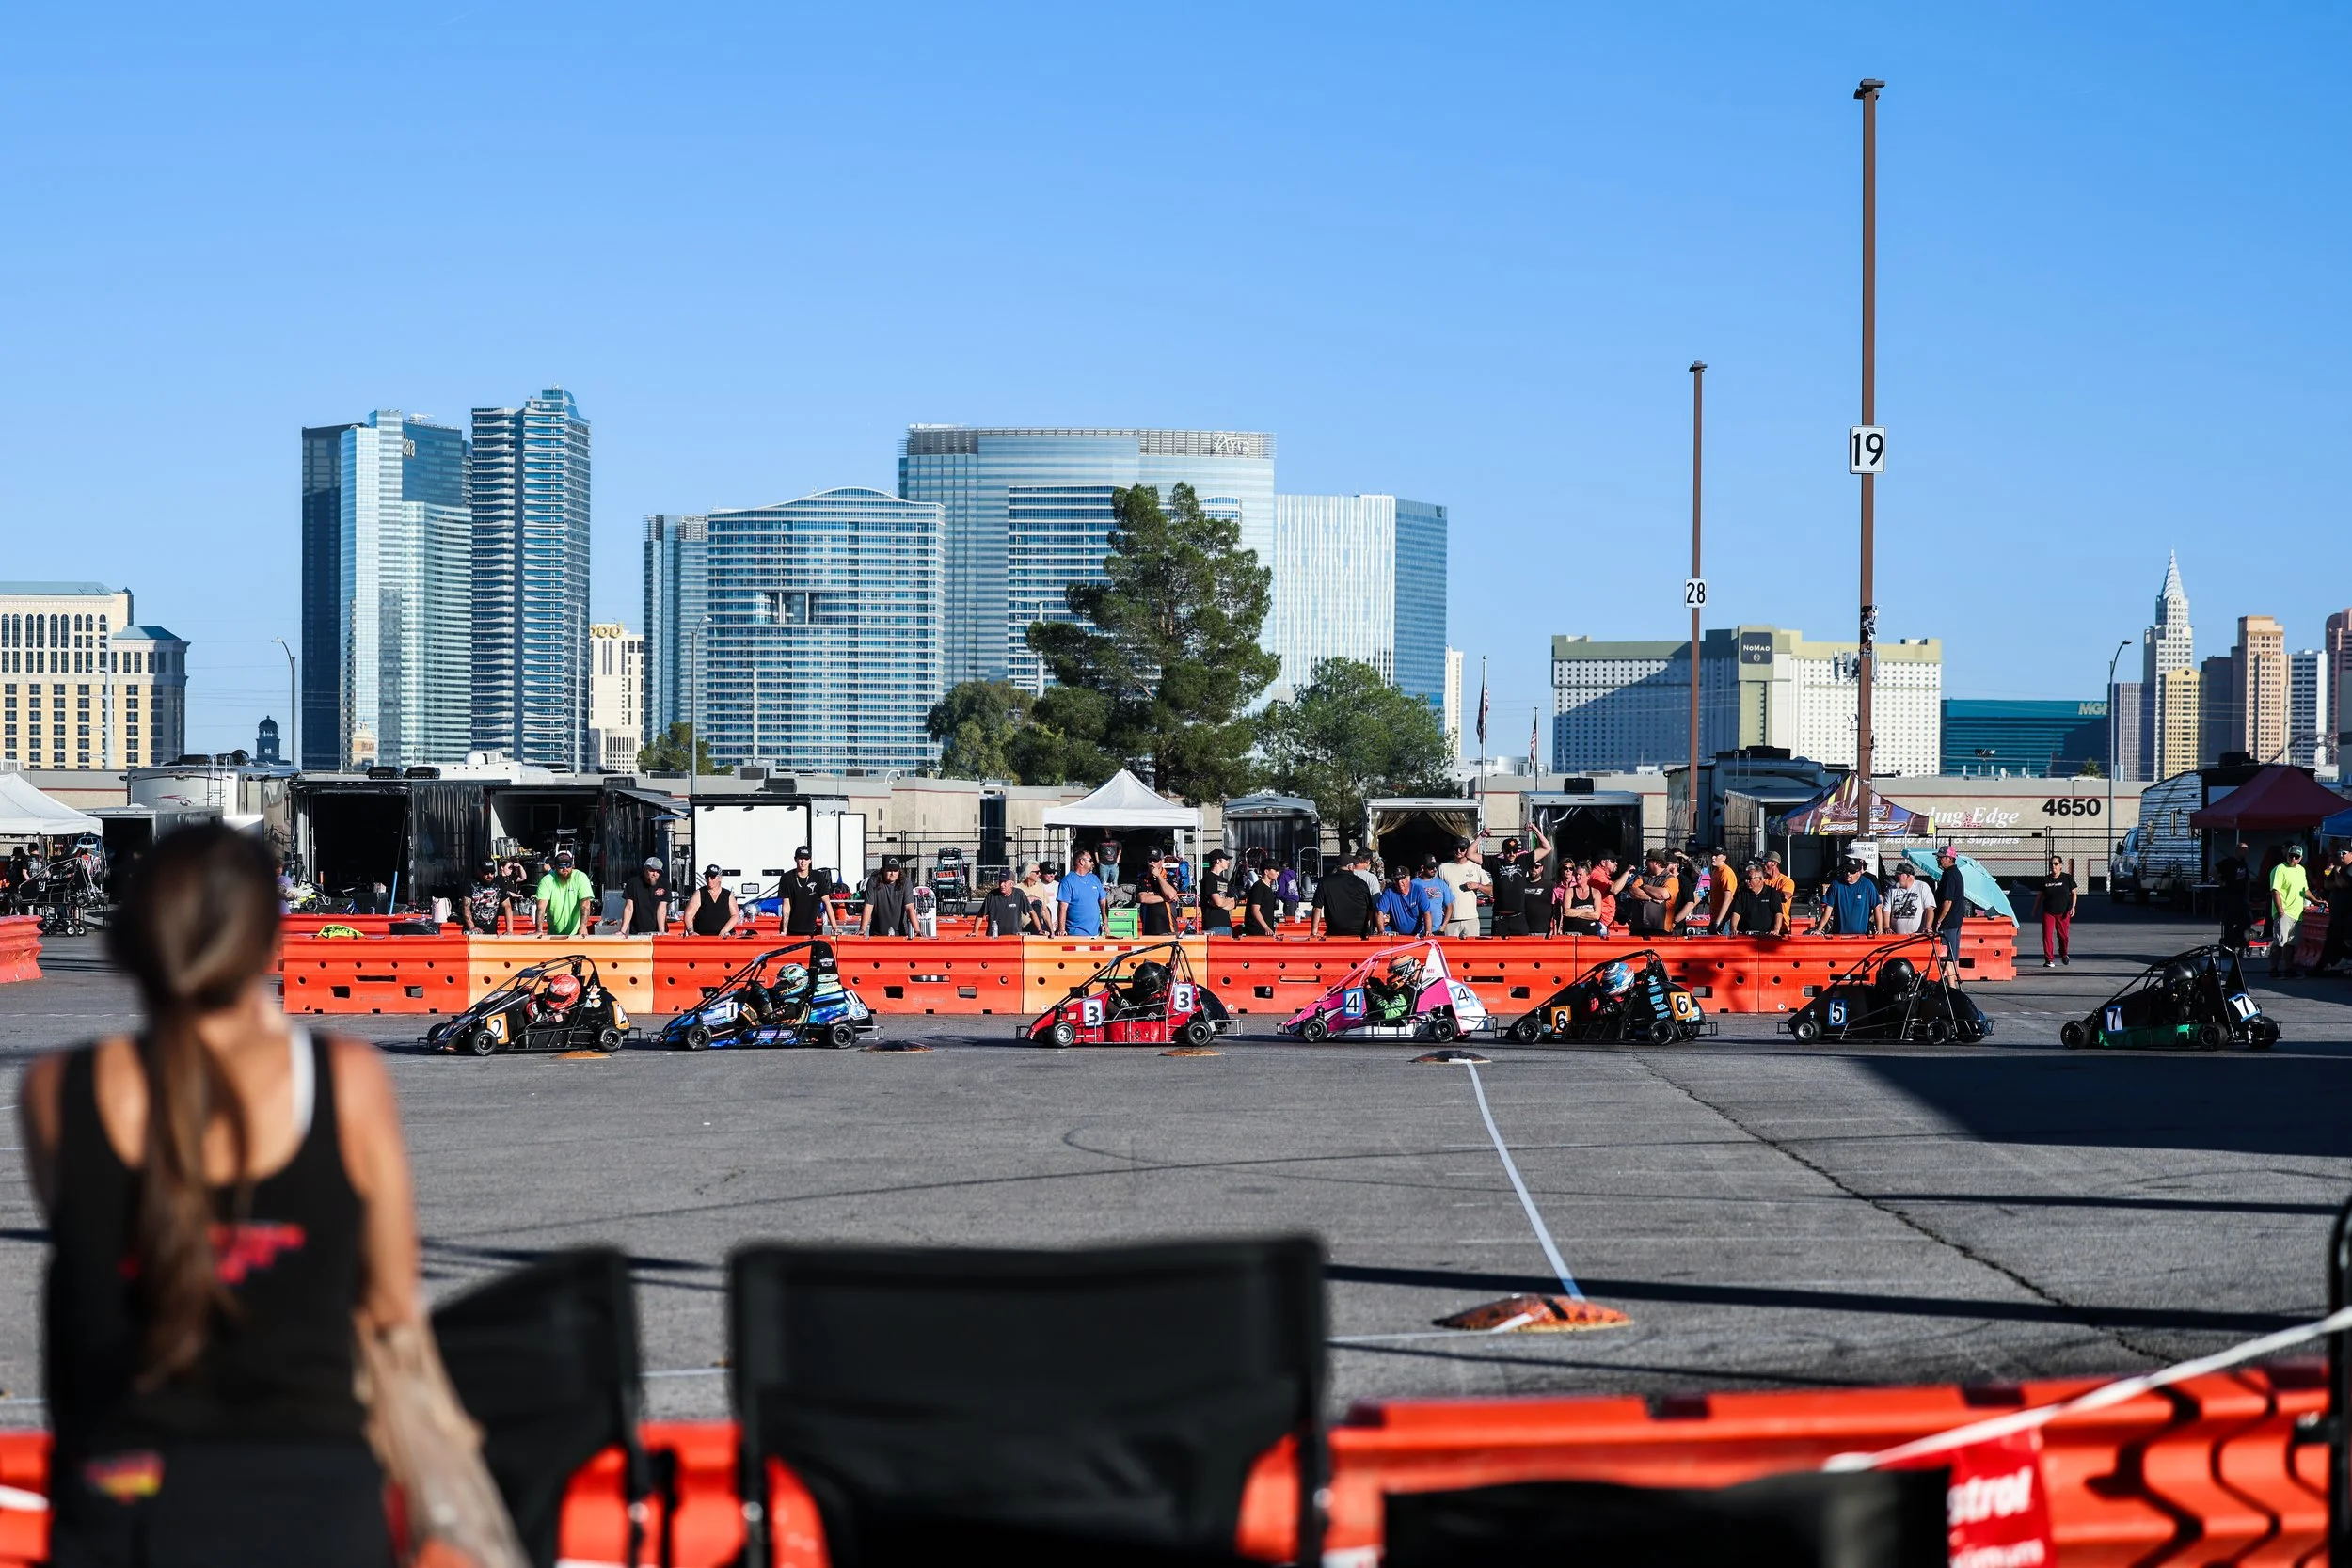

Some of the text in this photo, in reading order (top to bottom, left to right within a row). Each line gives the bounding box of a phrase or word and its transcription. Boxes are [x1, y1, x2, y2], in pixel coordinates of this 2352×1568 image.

[1853, 433, 1883, 466] 19
[1686, 582, 1706, 604] 28
[2042, 798, 2102, 816] 4650
[1972, 806, 2020, 828] Edge
[1966, 833, 2021, 846] Supplies
[849, 991, 858, 1004] 1
[1178, 991, 1190, 1008] 3
[1346, 993, 1359, 1012] 4
[1458, 988, 1470, 1002] 4
[1676, 995, 1688, 1014] 6
[728, 1003, 735, 1017] 1
[1088, 1006, 1099, 1022] 3
[1832, 1001, 1843, 1022] 5
[2234, 997, 2249, 1015] 7
[491, 1019, 503, 1039] 2
[1556, 1010, 1567, 1031] 6
[2108, 1008, 2118, 1031] 7
